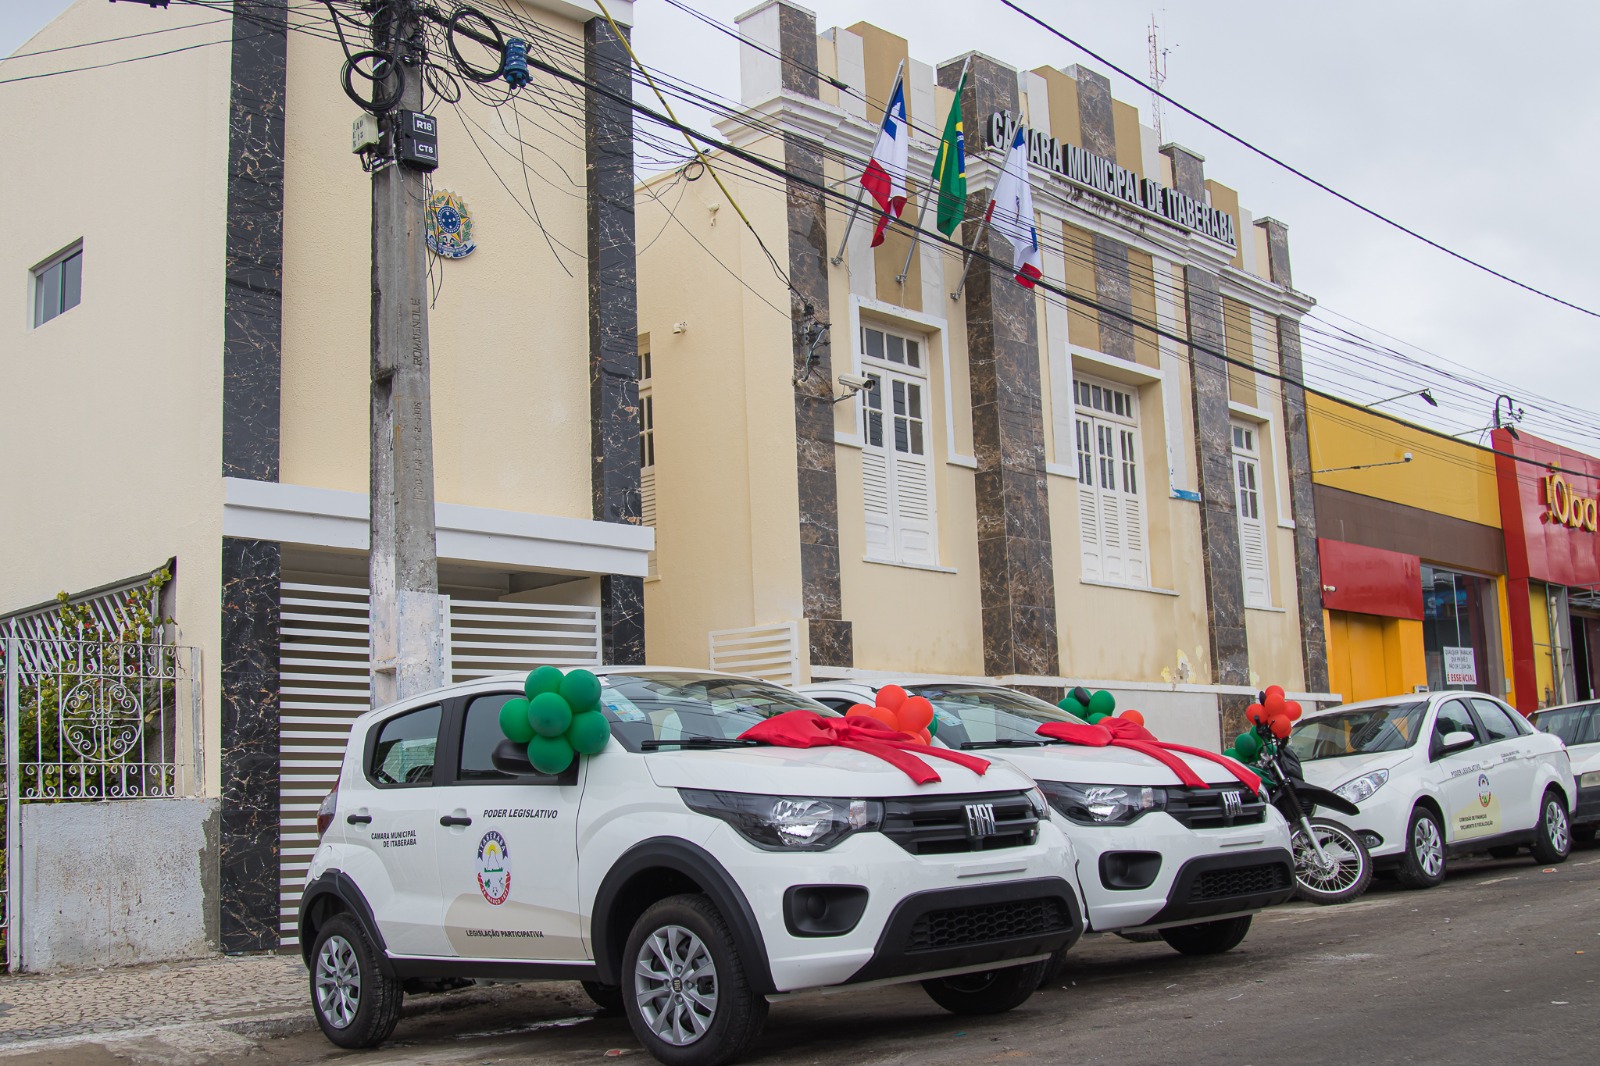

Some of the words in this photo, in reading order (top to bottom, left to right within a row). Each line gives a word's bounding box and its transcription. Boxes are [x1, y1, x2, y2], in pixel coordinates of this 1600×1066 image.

[417, 120, 432, 131] R18
[418, 144, 434, 154] CT8
[1066, 143, 1143, 207] MUNICIPAL
[1145, 179, 1165, 215] DE
[1166, 188, 1236, 245] ITABERABA
[1451, 673, 1475, 682] ESSENCIAL
[1221, 791, 1243, 816] FIAT
[483, 809, 507, 818] PODER
[508, 808, 558, 819] LEGISLATIVO
[965, 803, 996, 836] FIAT
[390, 829, 416, 839] MUNICIPAL
[383, 840, 389, 848] DE
[390, 838, 416, 848] ITABERABA
[479, 831, 506, 853] ITABERABA
[465, 929, 500, 939] LEGISLAÇÃO
[500, 930, 544, 938] PARTICIPATIVA
